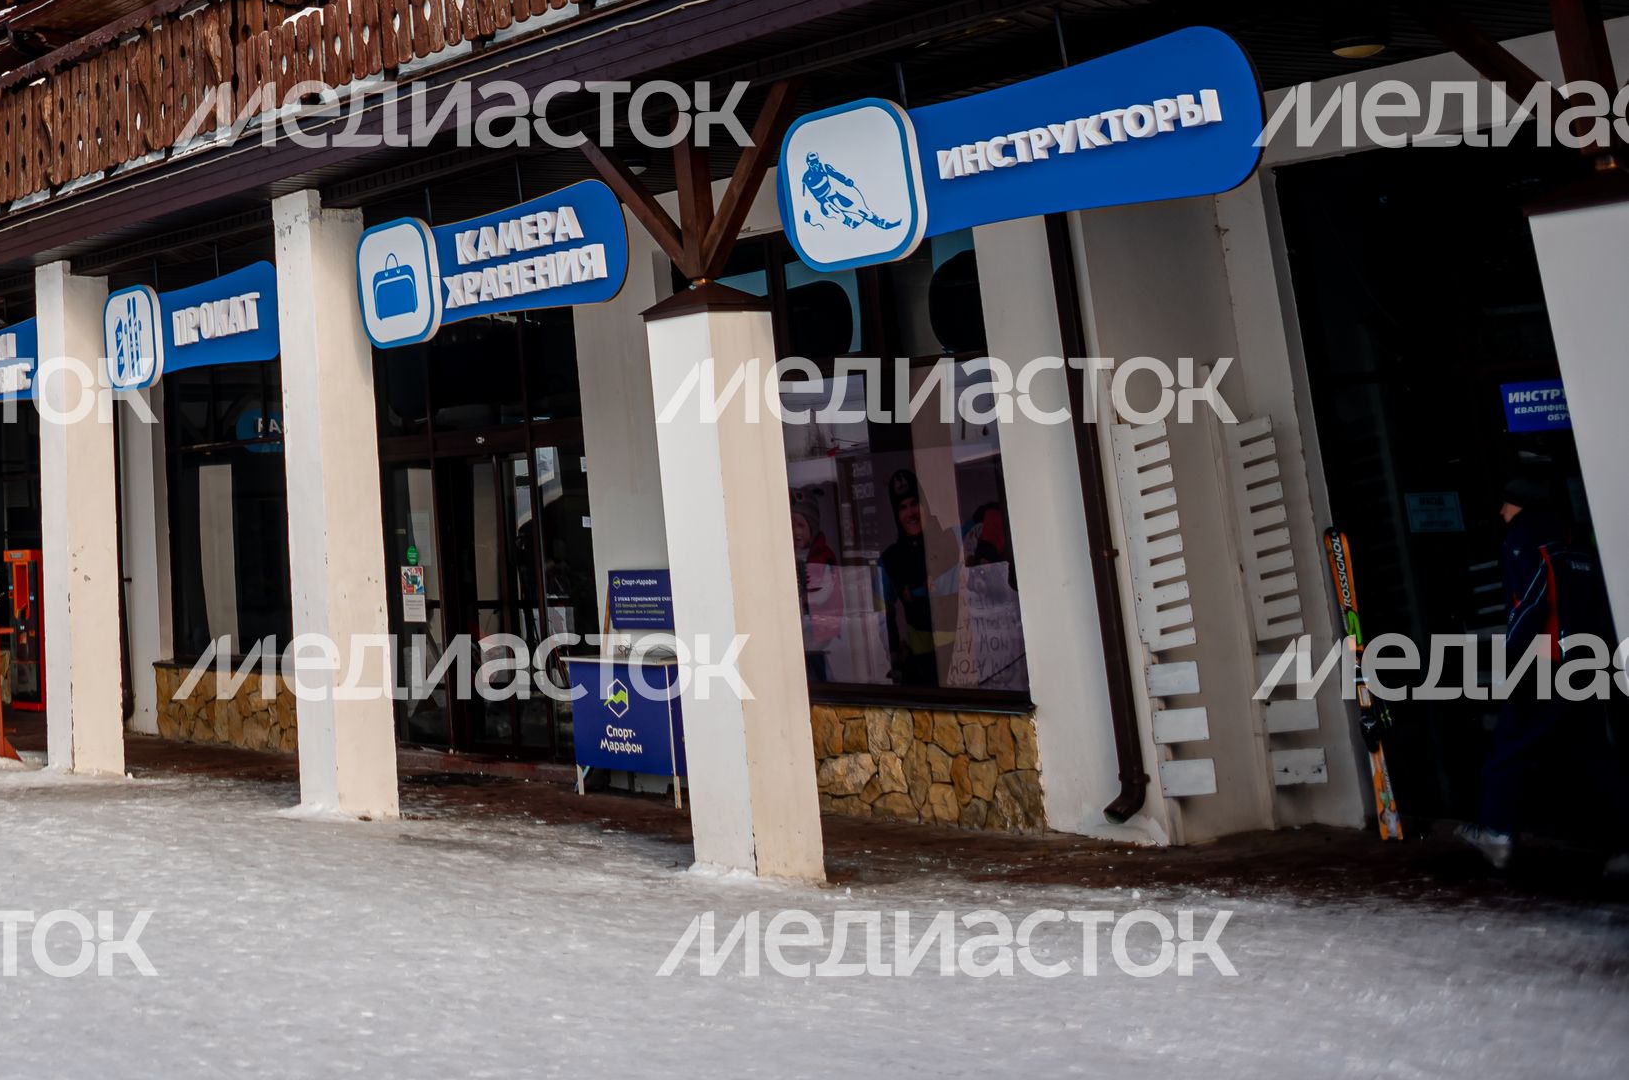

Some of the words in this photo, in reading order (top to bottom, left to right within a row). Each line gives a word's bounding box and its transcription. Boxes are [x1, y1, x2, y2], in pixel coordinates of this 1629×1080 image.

[936, 88, 1222, 180] ИНСТРУКТОРЫ
[454, 206, 585, 265] КАМЕРА
[442, 243, 609, 309] ХРАНЕНИЯ
[172, 292, 261, 347] ПРОКАТ
[1331, 535, 1352, 608] ROSSIGNOL
[600, 738, 643, 754] Марафон
[606, 724, 636, 740] Спорт-
